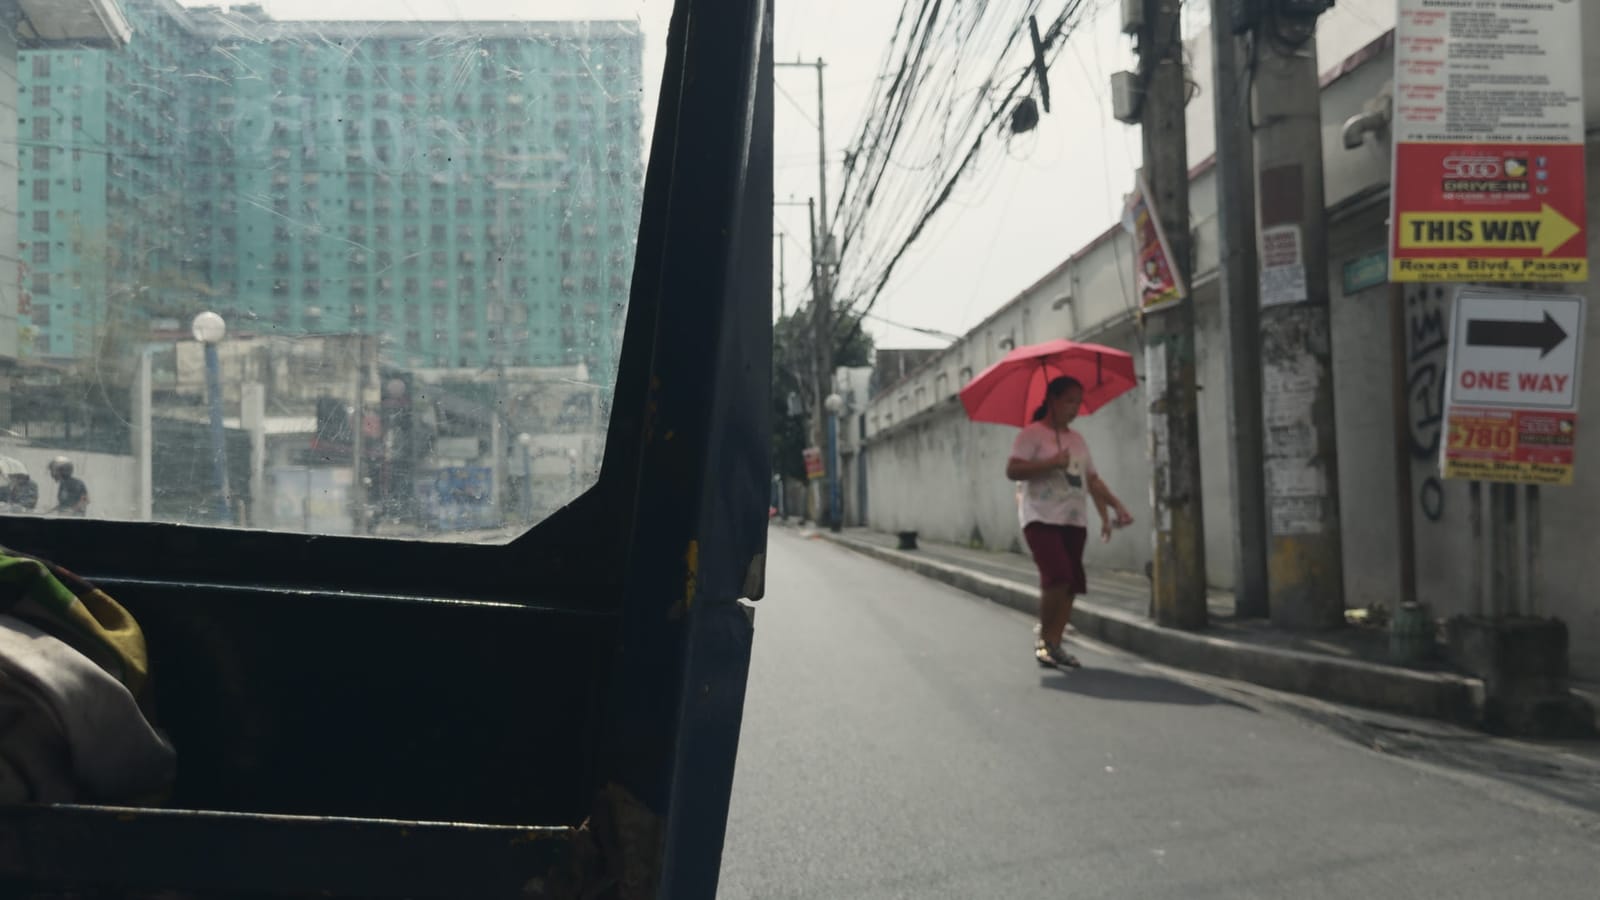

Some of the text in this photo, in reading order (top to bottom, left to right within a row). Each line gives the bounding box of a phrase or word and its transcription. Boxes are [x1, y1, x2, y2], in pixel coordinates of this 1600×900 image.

[1443, 156, 1501, 178] SOGO
[1444, 182, 1529, 193] DRIVE-IN
[1411, 220, 1541, 242] THIS WAY
[1399, 258, 1460, 271] Roxas
[1522, 258, 1581, 273] Pasay
[1461, 370, 1568, 393] ONE WAY
